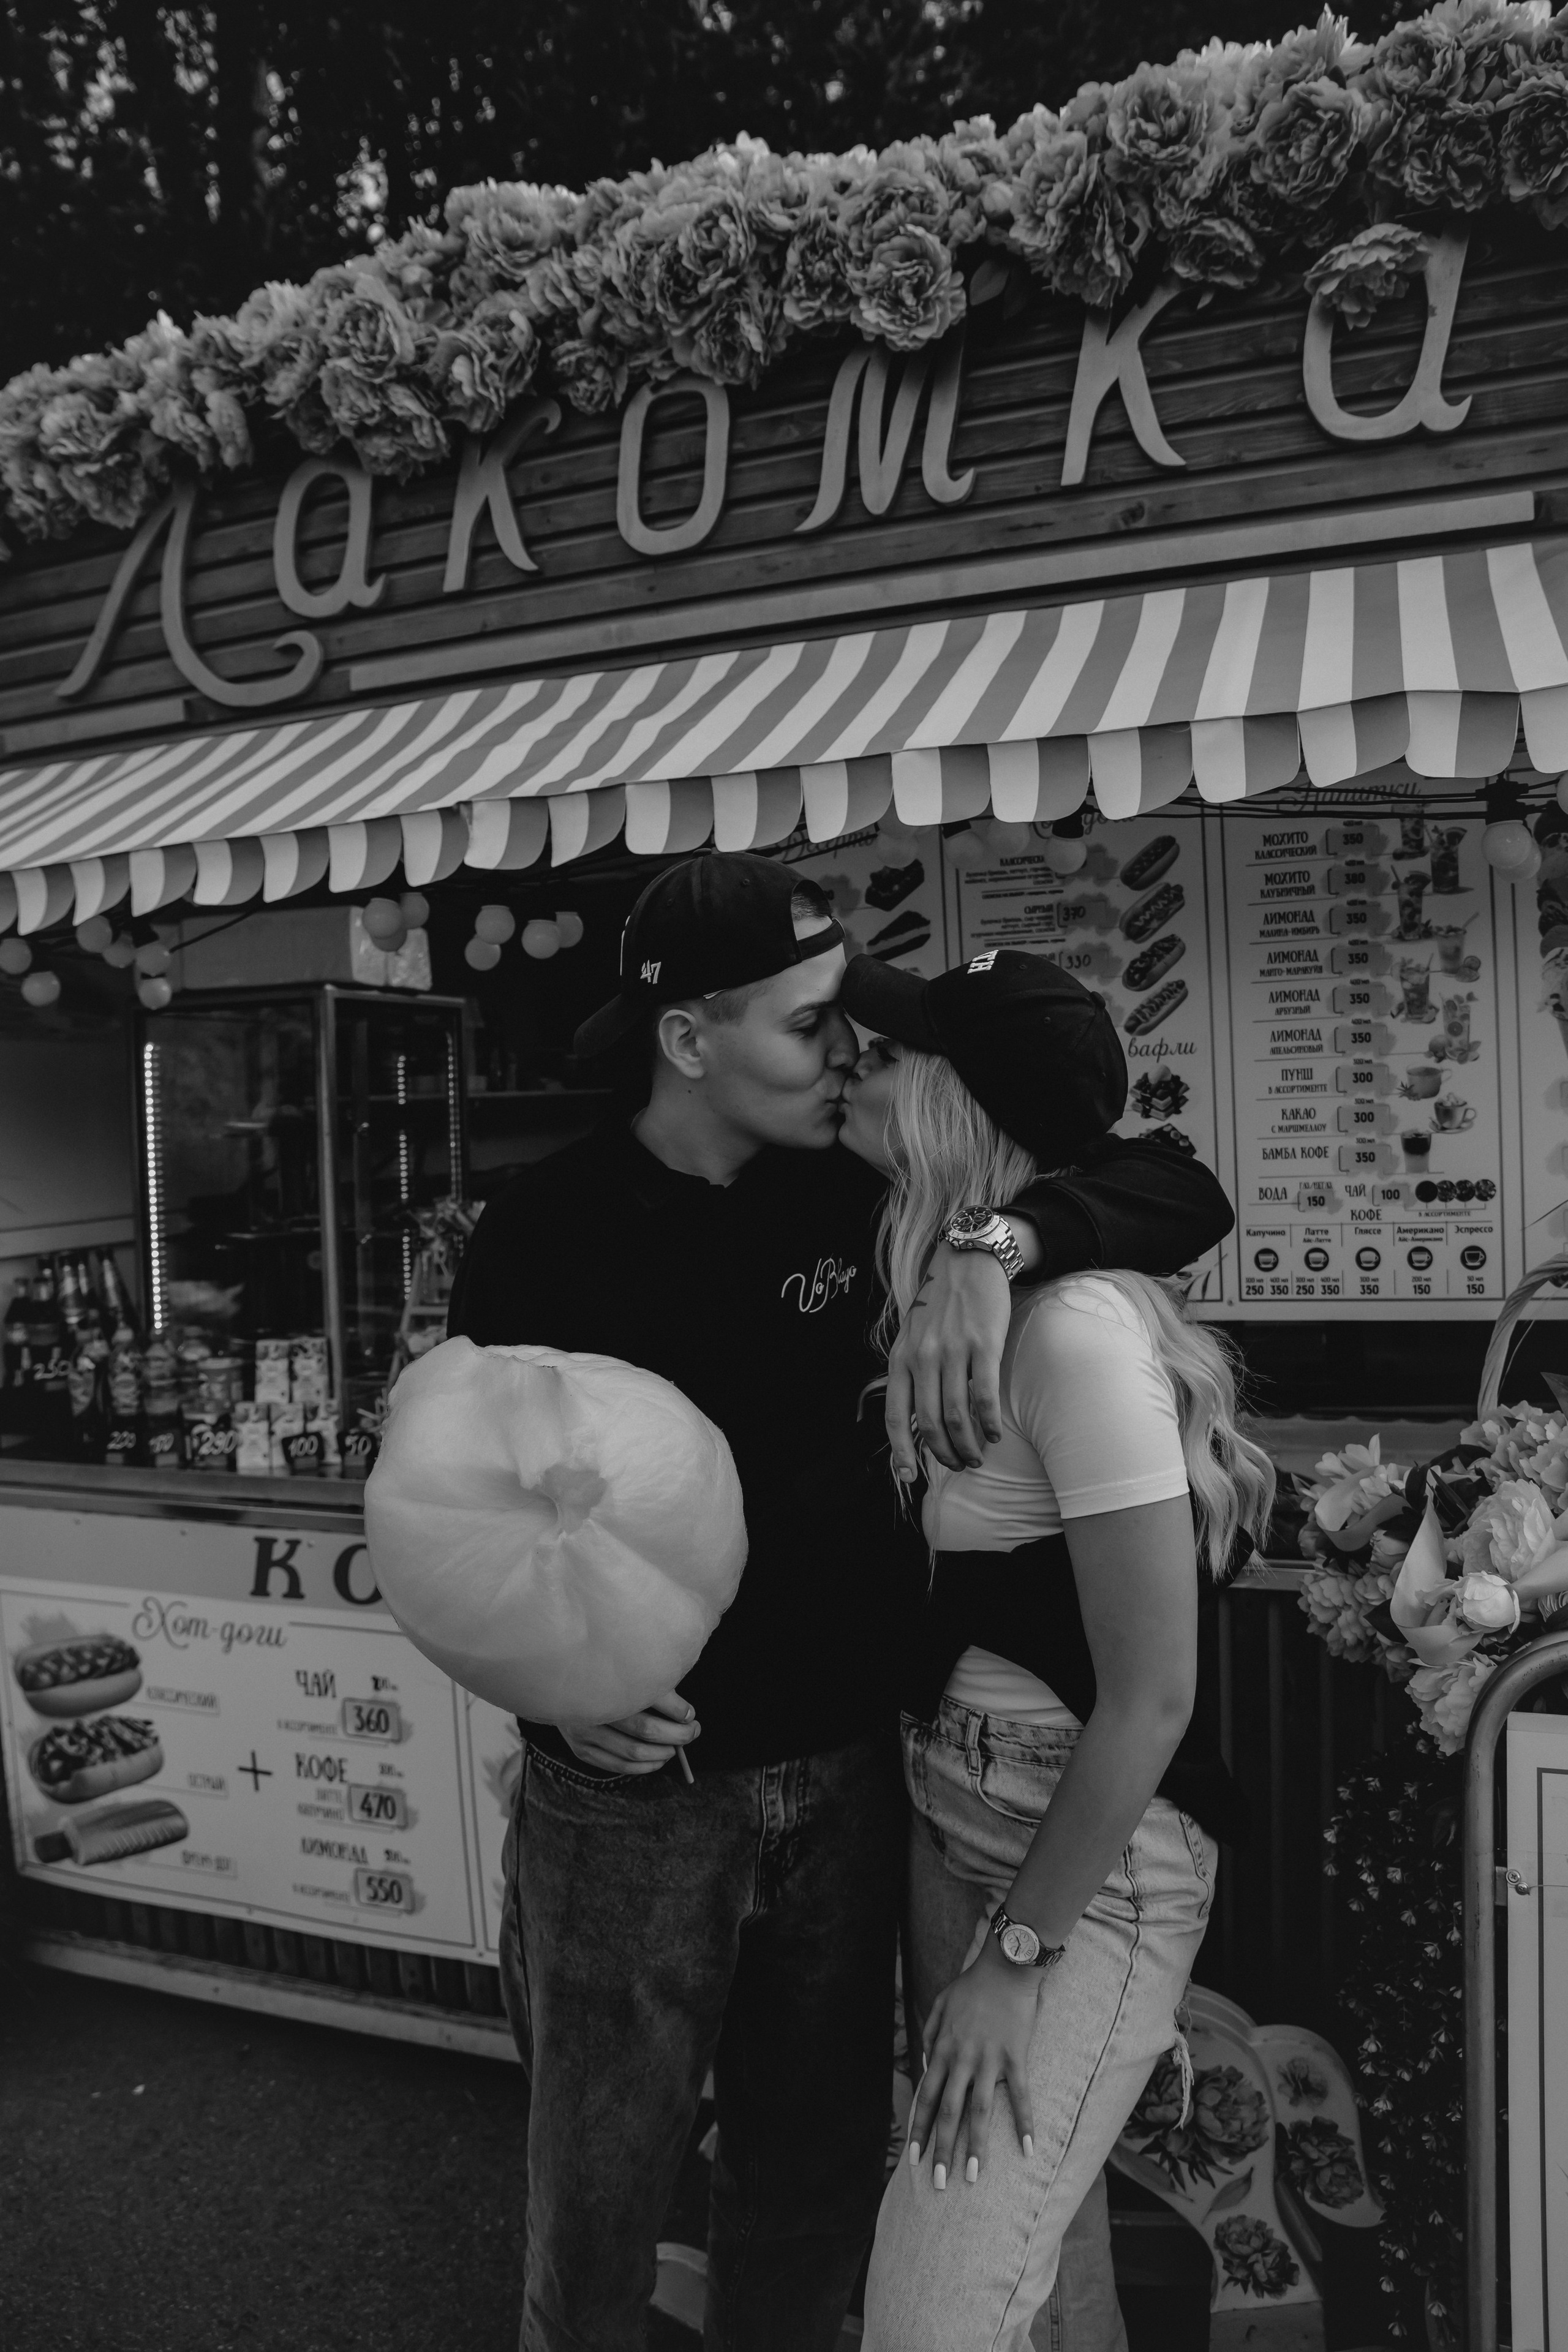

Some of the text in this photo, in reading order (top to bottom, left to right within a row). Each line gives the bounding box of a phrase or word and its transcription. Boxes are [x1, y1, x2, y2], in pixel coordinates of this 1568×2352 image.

[56, 214, 1472, 707] Лакомка
[1262, 831, 1309, 846] МОХИТО
[1343, 833, 1363, 845] 350
[1255, 845, 1317, 860] КЛАССИЧЕСКИЙ
[1264, 870, 1310, 886] МОХИТО
[1261, 884, 1316, 899] КЛУБНИЧНЫЙ
[1063, 905, 1085, 922] 370
[1263, 910, 1316, 925] ЛИМОНАД
[1346, 913, 1366, 924] 350
[1066, 954, 1091, 970] 330
[1267, 949, 1319, 965] ЛИМОНАД
[1348, 952, 1368, 964] 350
[640, 959, 662, 985] 47
[1268, 989, 1321, 1004] ЛИМОНАД
[1349, 993, 1370, 1005] 350
[1275, 1005, 1311, 1016] АРБУЗНЫЙ
[1270, 1028, 1322, 1042] ЛИМОНАД
[1351, 1032, 1371, 1044] 350
[1128, 1037, 1197, 1063] вафли
[1270, 1044, 1323, 1055] АПЕЛЬСИНОВЫЙ
[1281, 1068, 1313, 1081] ПУНШ
[1352, 1072, 1373, 1084] 300
[1274, 1084, 1327, 1094] АССОРТИМЕНТЕ
[1281, 1107, 1316, 1121] КАКАО
[1354, 1112, 1374, 1123] 300
[1278, 1123, 1327, 1133] МАРШМЕЛЛОУ
[1262, 1145, 1330, 1160] БАМБЛ КОФЕ
[1355, 1152, 1376, 1163] 350
[1258, 1186, 1287, 1201] ВОДА
[1344, 1183, 1366, 1197] ЧАЙ
[1381, 1189, 1400, 1200] 100
[1307, 1196, 1325, 1207] 150
[1350, 1208, 1382, 1221] КОФЕ
[1246, 1228, 1286, 1238] Капучино
[1305, 1227, 1329, 1236] Латте
[1354, 1226, 1382, 1235] Гляссе
[1396, 1226, 1445, 1236] Американо
[1455, 1226, 1493, 1235] Эспрессо
[1245, 1285, 1264, 1295] 250
[1270, 1285, 1288, 1295] 350
[1295, 1285, 1314, 1295] 250
[1321, 1284, 1340, 1295] 350
[1359, 1284, 1379, 1295] 350
[1412, 1284, 1431, 1294] 150
[1466, 1284, 1485, 1294] 150
[288, 1435, 318, 1457] 100
[132, 1596, 288, 1655] Хот-доги
[295, 1669, 337, 1698] ЧАЙ
[353, 1705, 390, 1733] 360
[295, 1752, 349, 1783] КОФЕ
[360, 1792, 397, 1820] 470
[366, 1875, 403, 1904] 550
